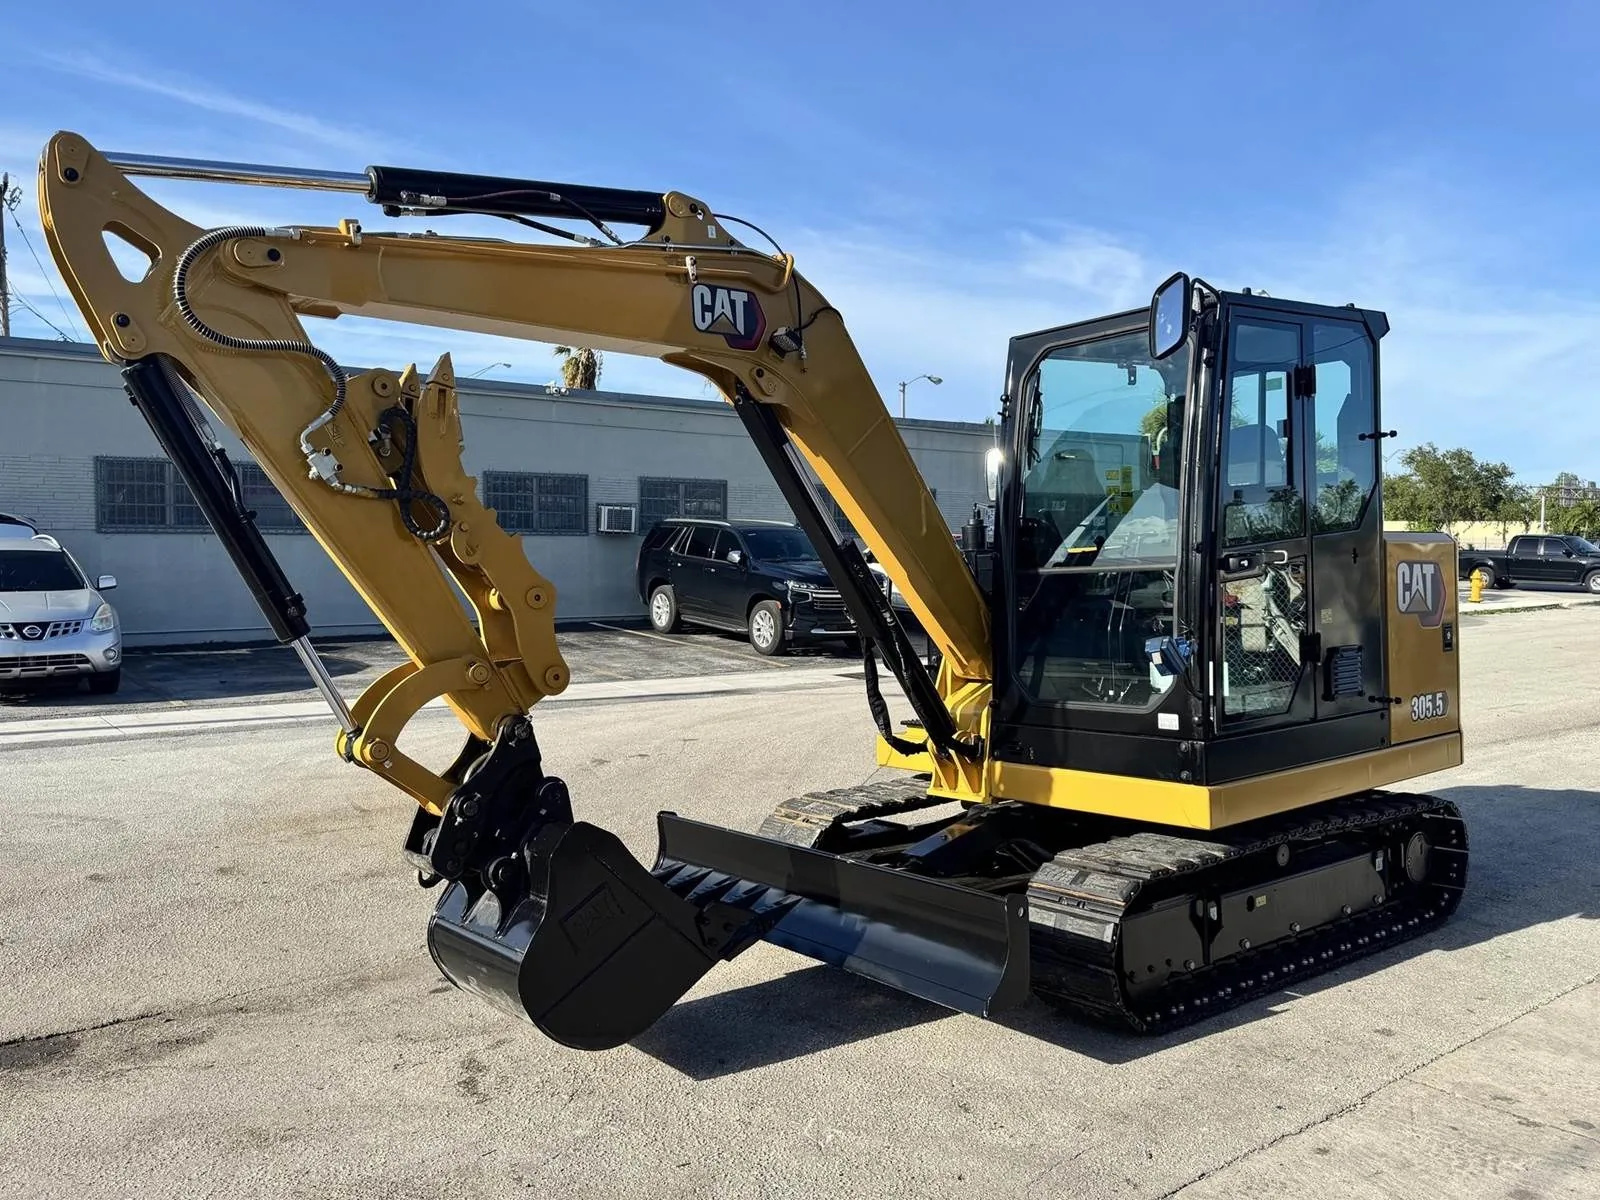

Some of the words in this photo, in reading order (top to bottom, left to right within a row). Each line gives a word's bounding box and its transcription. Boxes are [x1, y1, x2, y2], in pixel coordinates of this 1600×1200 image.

[693, 284, 748, 336] CAT
[1397, 562, 1435, 612] CAT
[1411, 692, 1443, 721] 305.5
